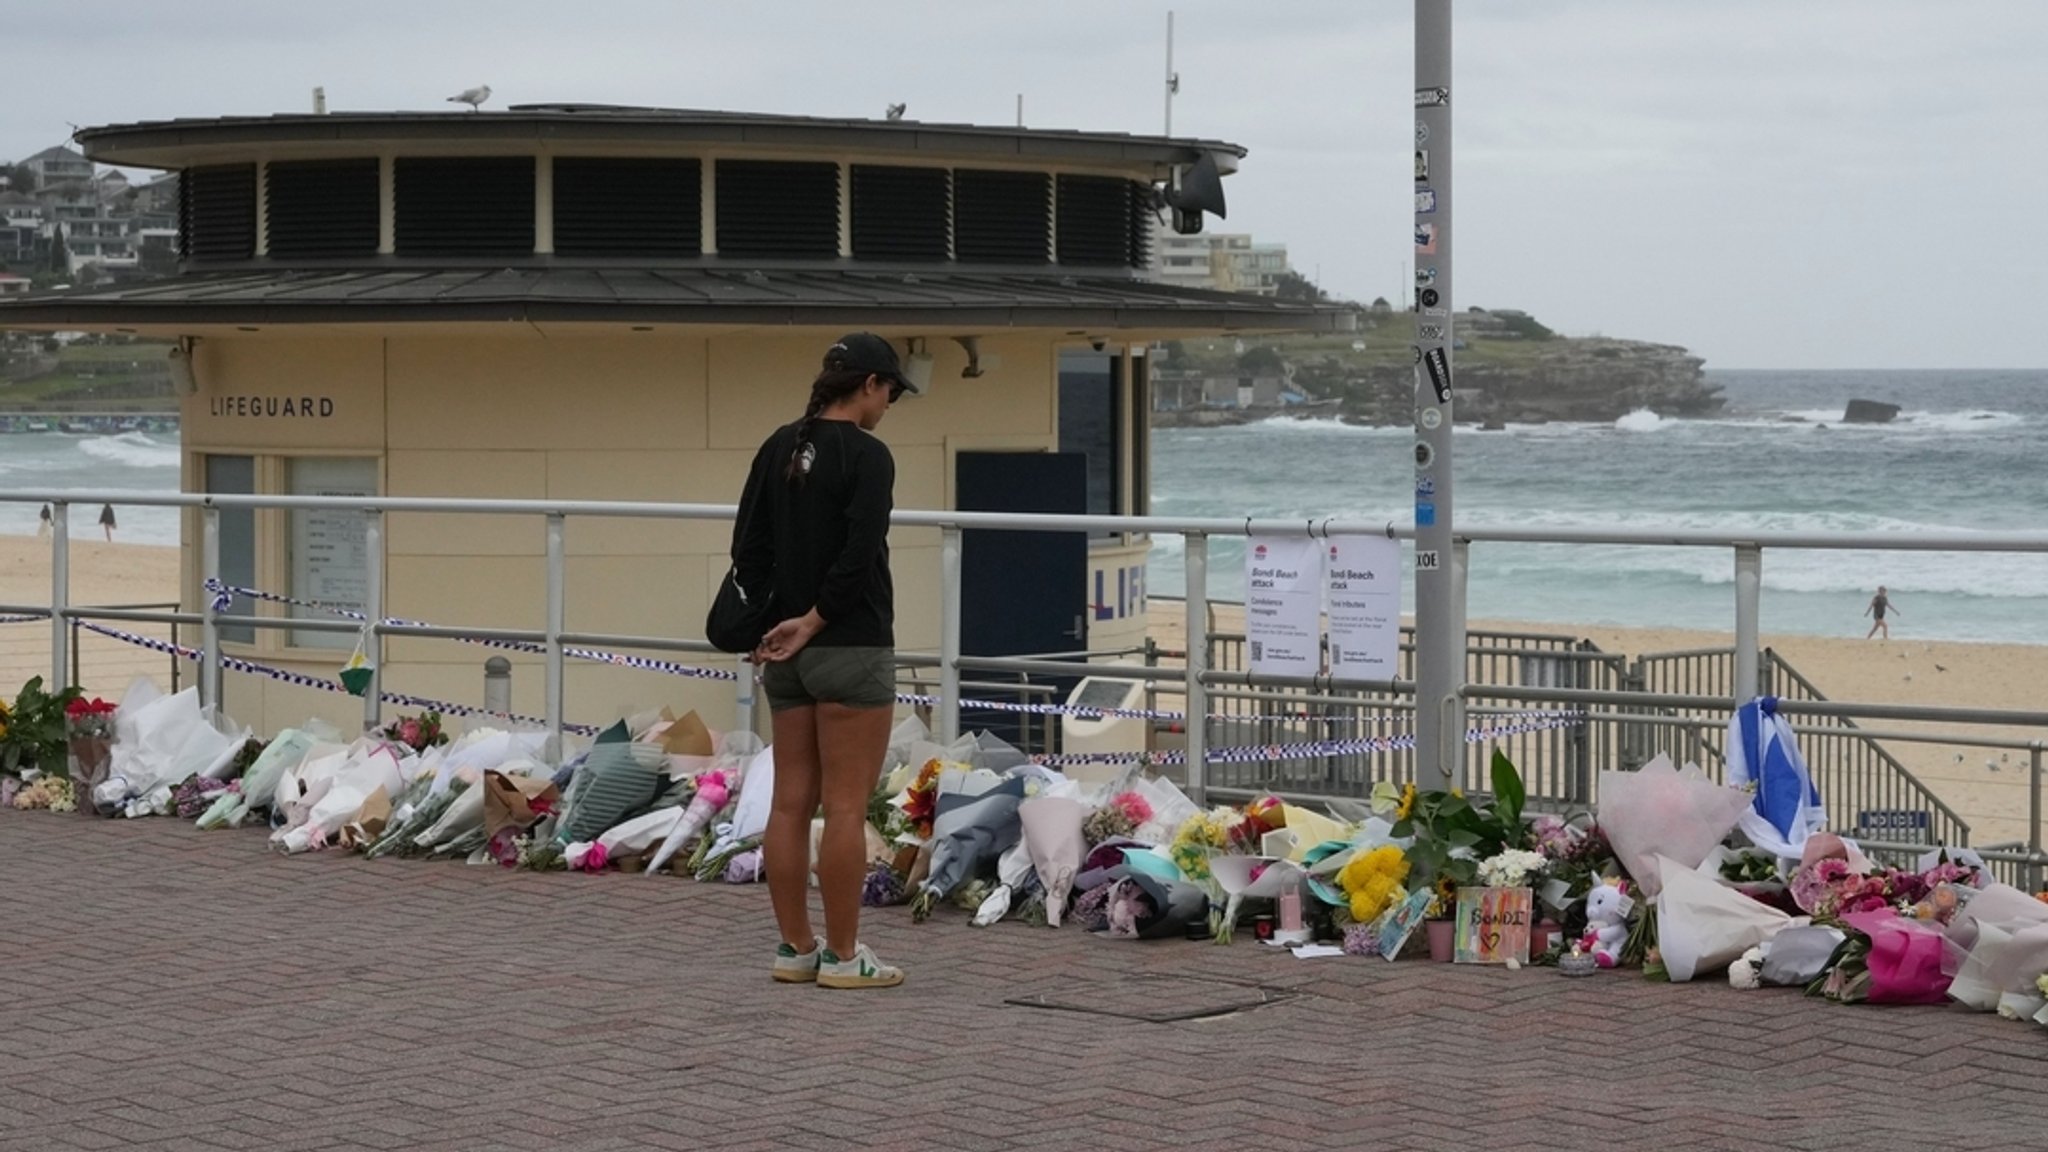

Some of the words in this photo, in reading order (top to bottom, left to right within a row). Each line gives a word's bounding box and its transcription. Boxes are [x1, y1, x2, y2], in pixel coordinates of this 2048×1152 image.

[210, 396, 334, 417] LIFEGUARD
[1251, 567, 1274, 578] Bondi
[1275, 569, 1298, 579] Beach
[1347, 569, 1374, 580] Beach
[1251, 579, 1274, 588] attack
[1471, 907, 1525, 926] BONDI
